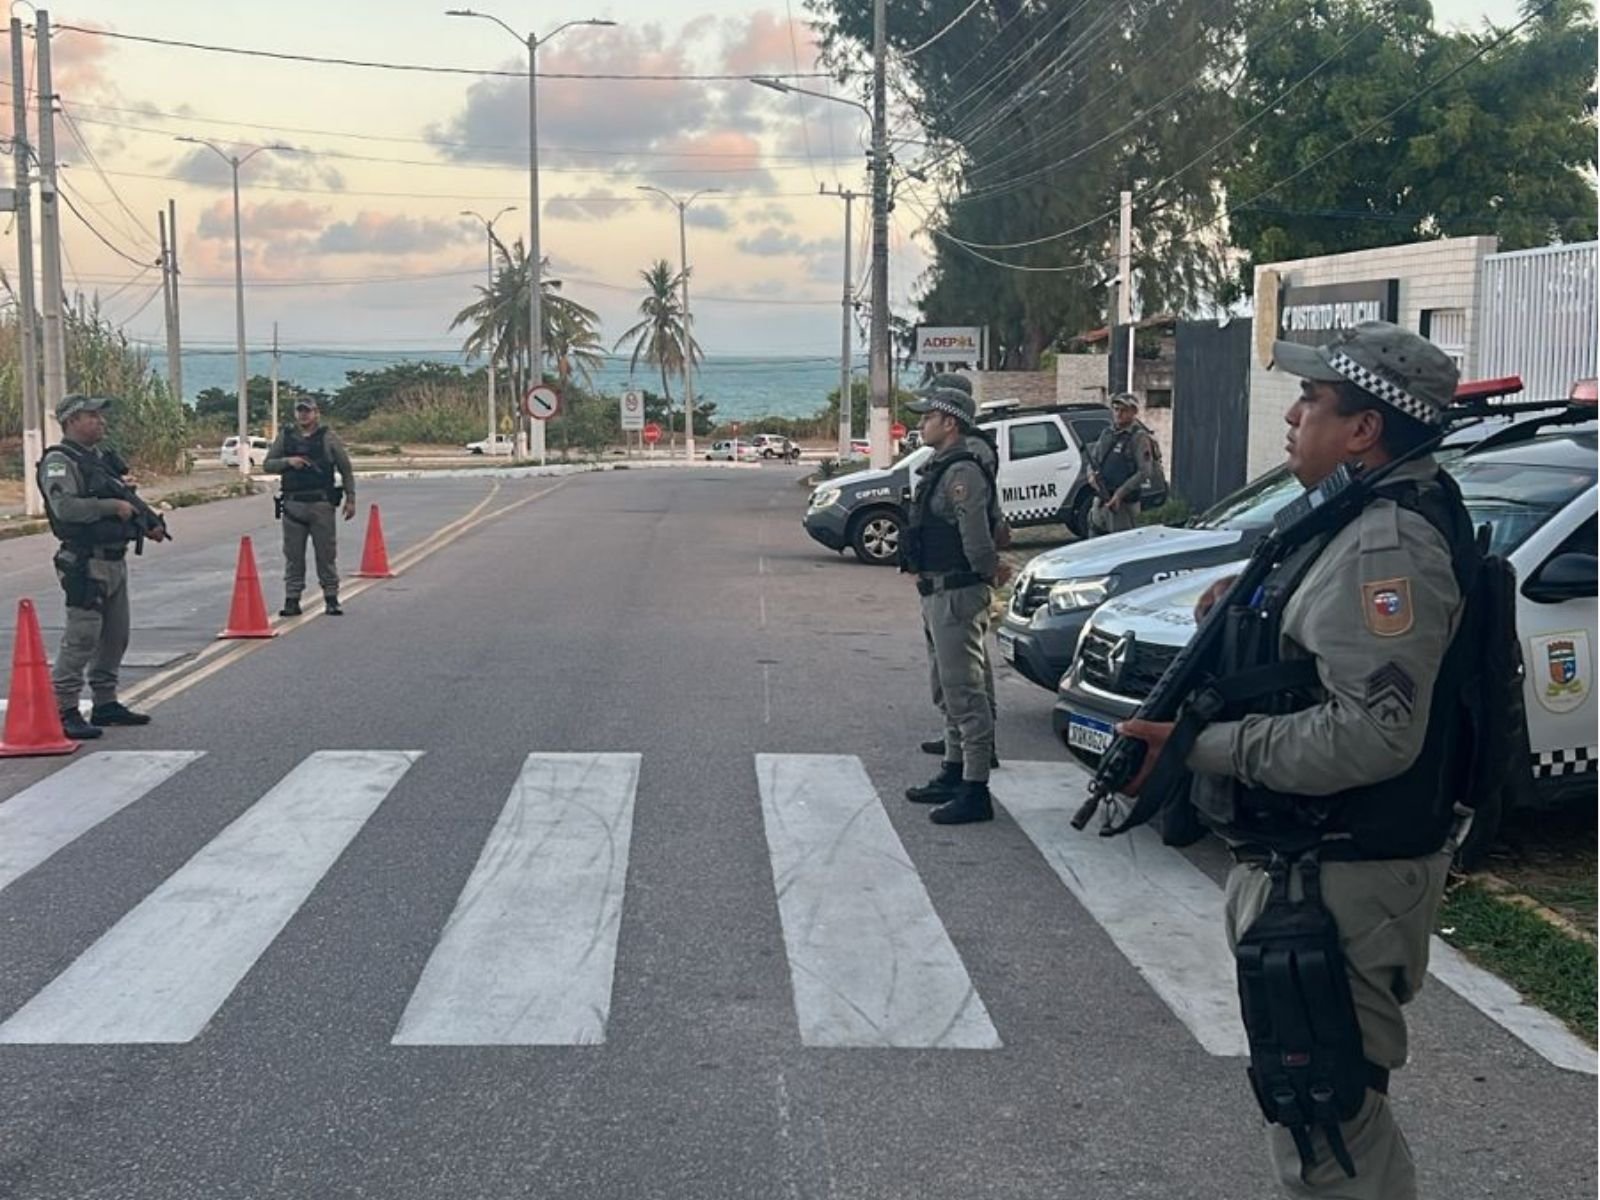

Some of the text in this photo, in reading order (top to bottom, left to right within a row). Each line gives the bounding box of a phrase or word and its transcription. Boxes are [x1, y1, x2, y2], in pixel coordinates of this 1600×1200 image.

[1291, 303, 1334, 331] DISTRITO
[856, 487, 891, 499] CIPTUR
[1003, 483, 1058, 503] MILITAR
